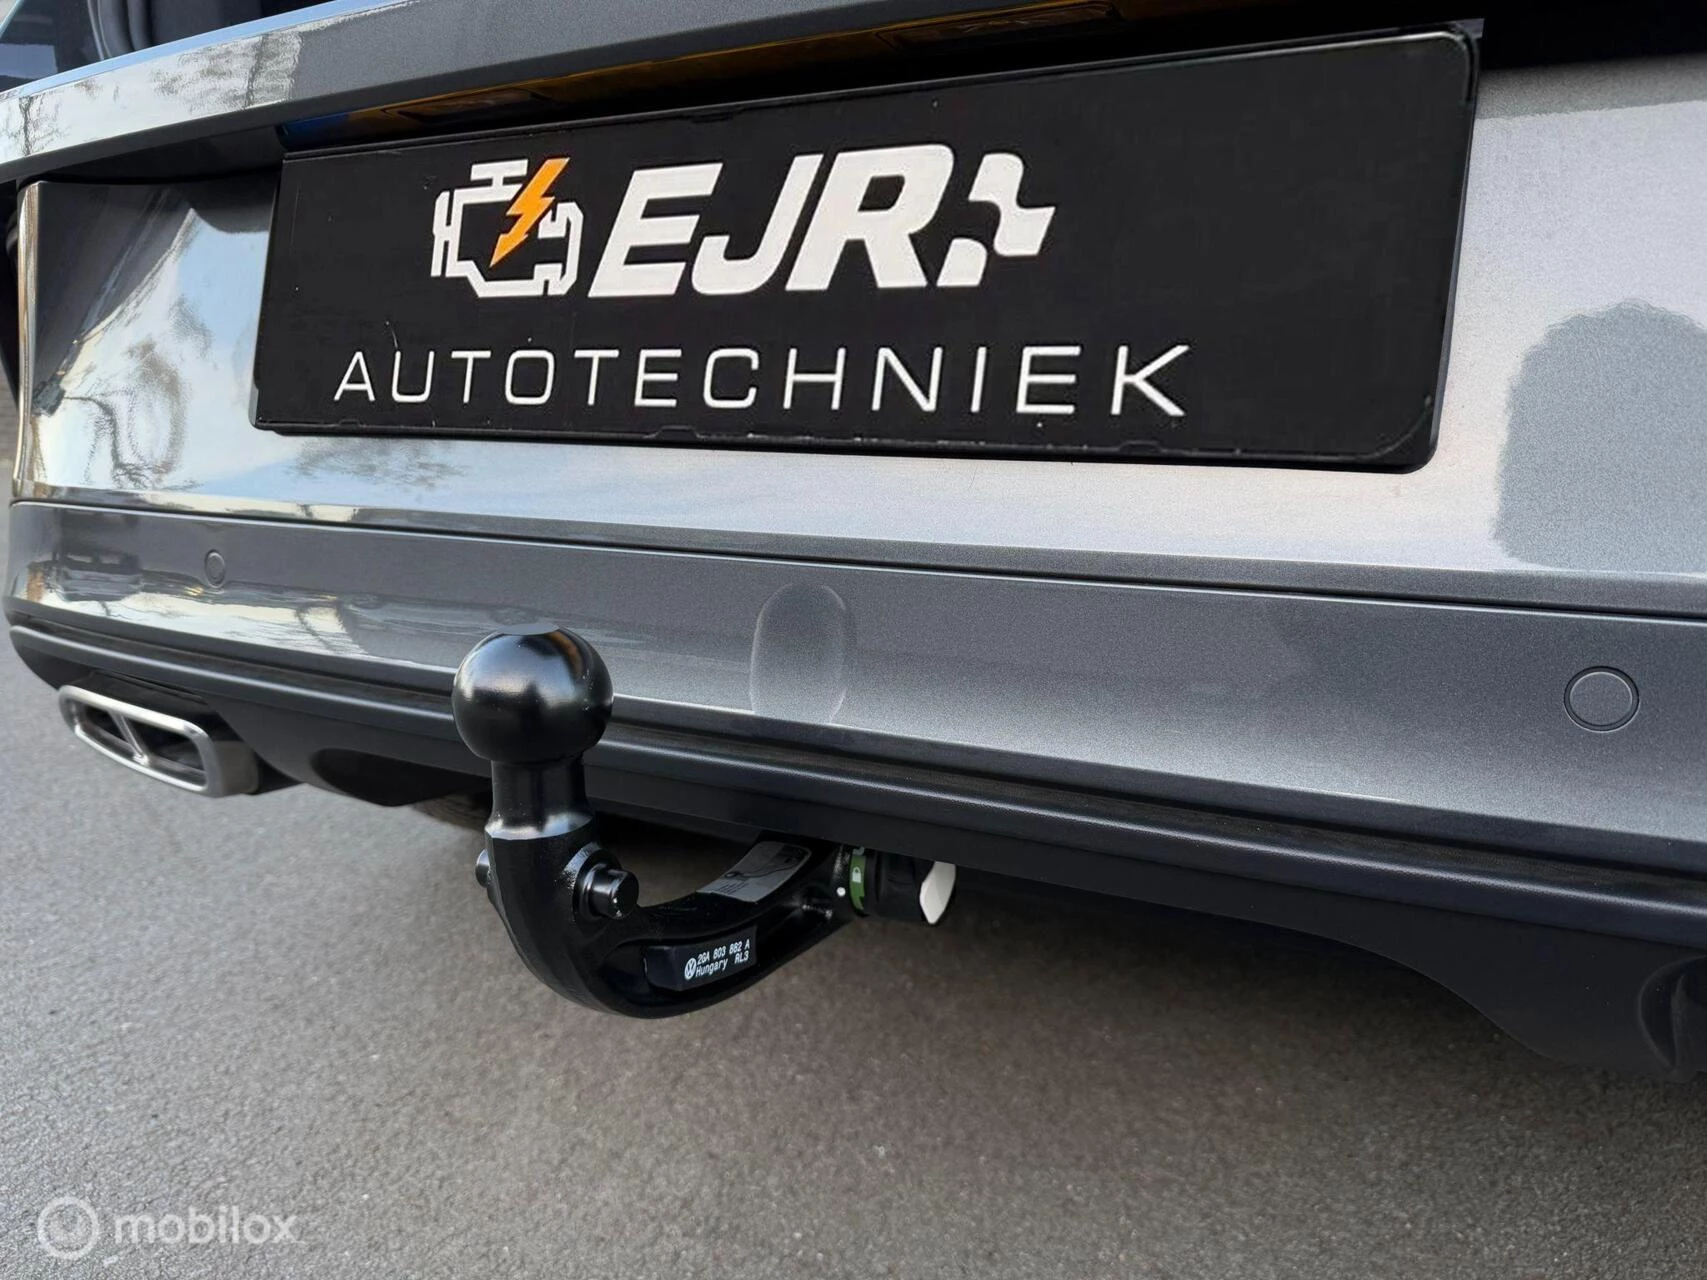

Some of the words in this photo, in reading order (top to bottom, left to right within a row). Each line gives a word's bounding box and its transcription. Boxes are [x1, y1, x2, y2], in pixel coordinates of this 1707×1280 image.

[333, 344, 1189, 418] AUTOTECHNIEK
[744, 938, 750, 950] A
[695, 958, 728, 977] Hungary
